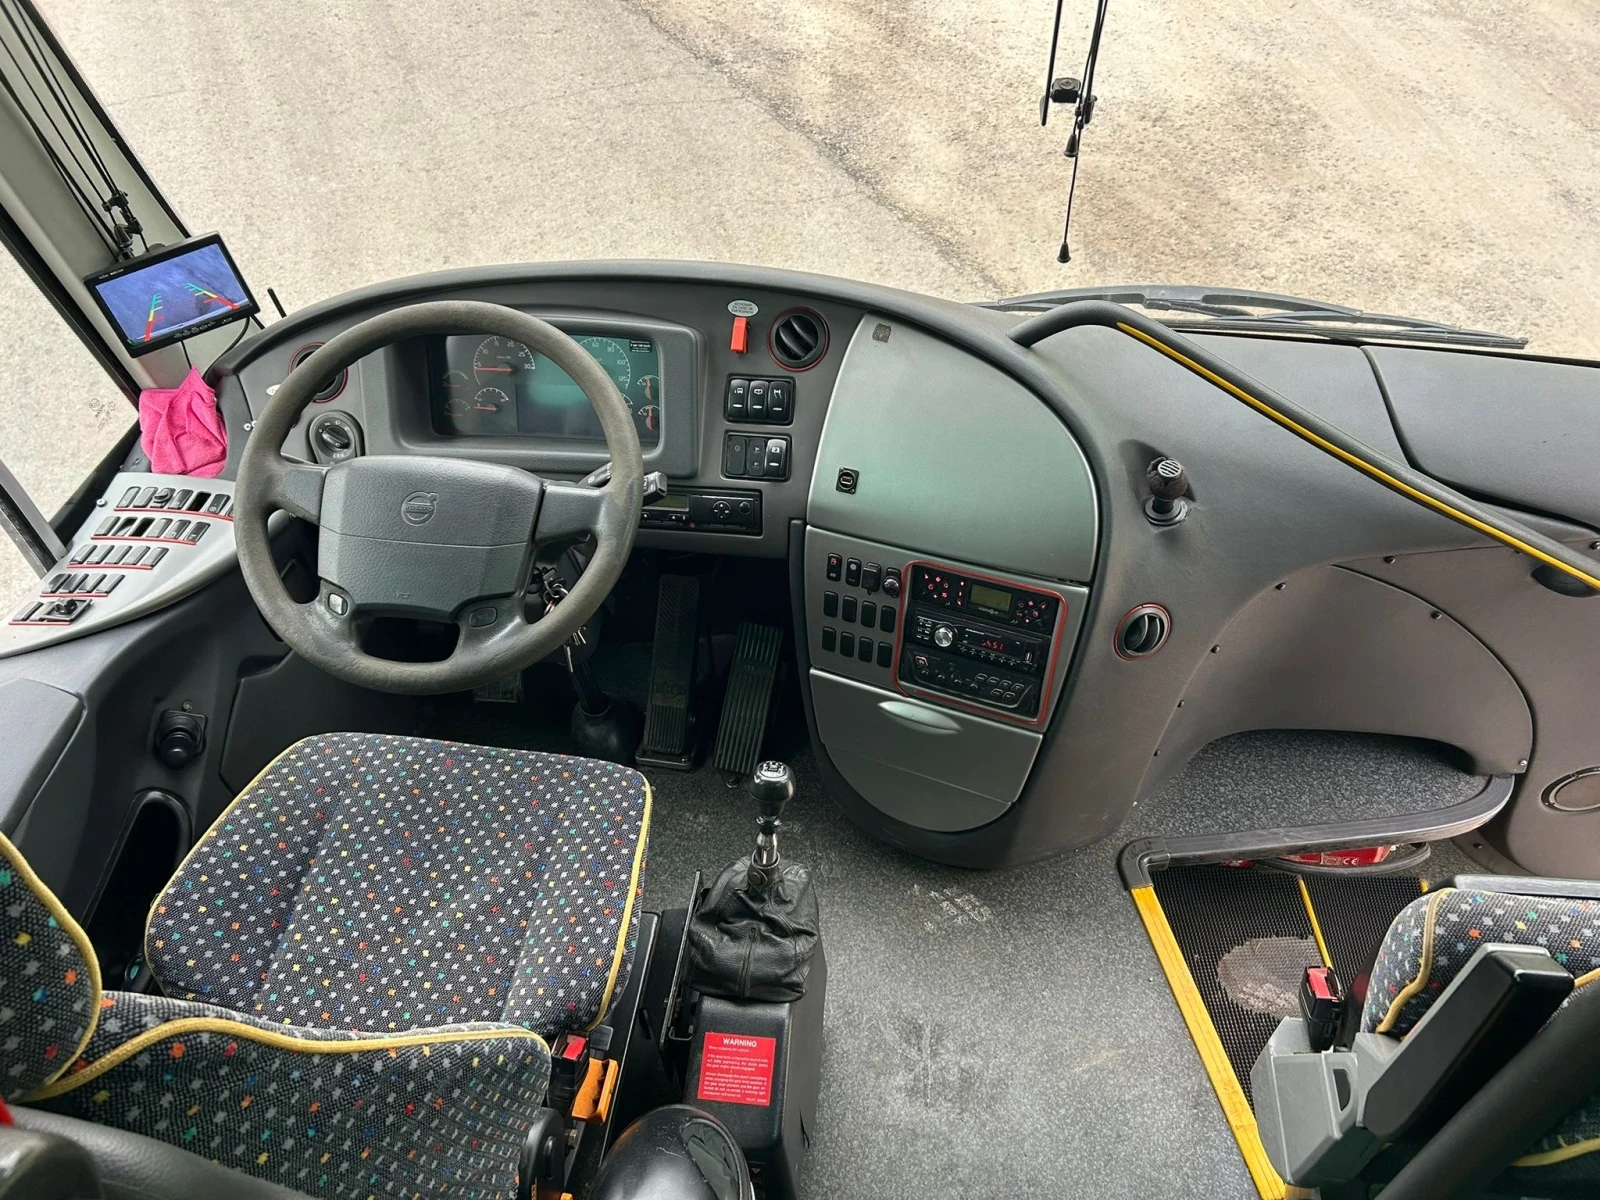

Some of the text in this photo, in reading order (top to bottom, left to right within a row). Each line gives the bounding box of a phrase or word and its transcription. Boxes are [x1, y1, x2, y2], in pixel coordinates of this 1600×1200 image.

[507, 340, 515, 348] 20
[1343, 857, 1358, 866] CE
[723, 1037, 757, 1048] WARNING
